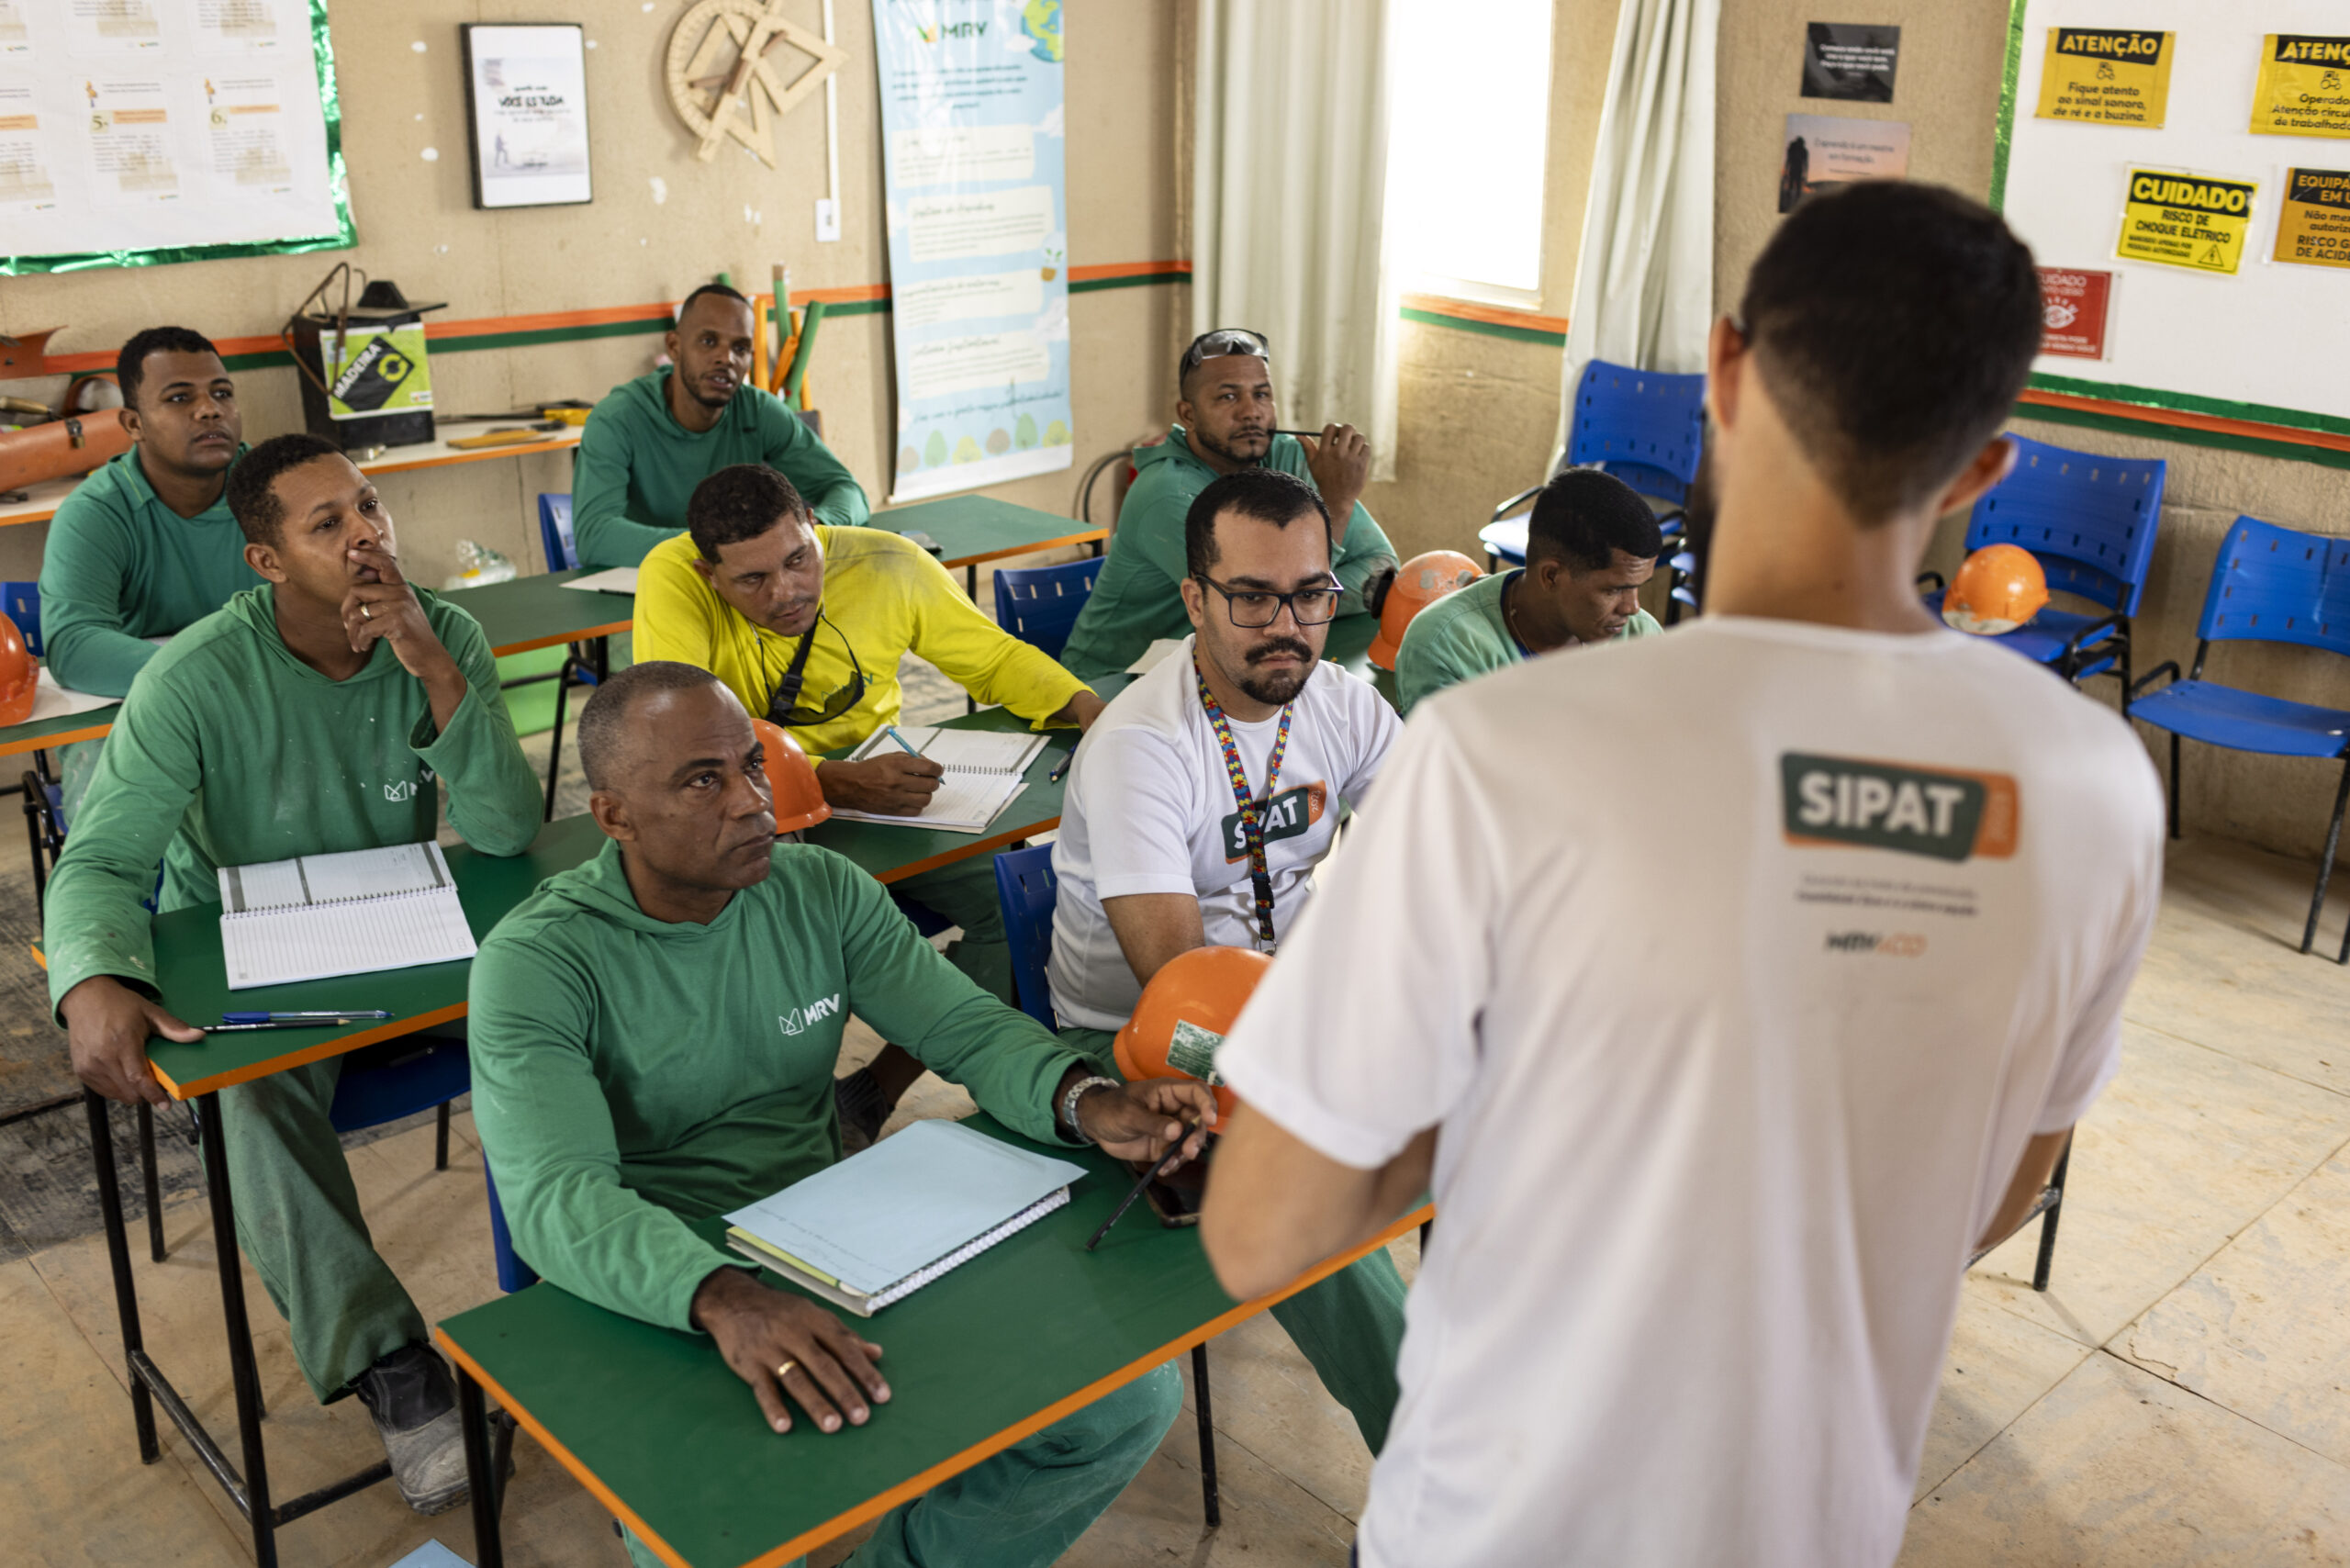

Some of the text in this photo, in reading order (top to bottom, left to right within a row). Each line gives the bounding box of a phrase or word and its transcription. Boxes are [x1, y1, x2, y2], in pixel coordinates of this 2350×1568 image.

[942, 20, 987, 39] MRV
[2062, 34, 2157, 57] ATENÇÃO
[2068, 82, 2140, 96] Fique atento
[2057, 95, 2146, 110] ao sinal sonoro,
[2272, 104, 2319, 117] Atenção
[2053, 106, 2067, 117] de
[2070, 107, 2081, 118] ré
[2104, 109, 2146, 122] buzina.
[2274, 117, 2288, 126] de
[2133, 176, 2246, 213] CUIDADO
[2321, 190, 2342, 202] EM
[2162, 209, 2210, 226] RISCO DE
[2304, 210, 2327, 220] Não
[2135, 219, 2178, 236] CHOQUE
[2297, 234, 2336, 248] RISCO
[2296, 246, 2313, 258] DE
[333, 343, 383, 399] MADEIRA
[1799, 771, 1965, 837] SIPAT
[1234, 795, 1298, 849] SAT
[803, 993, 840, 1025] MRV
